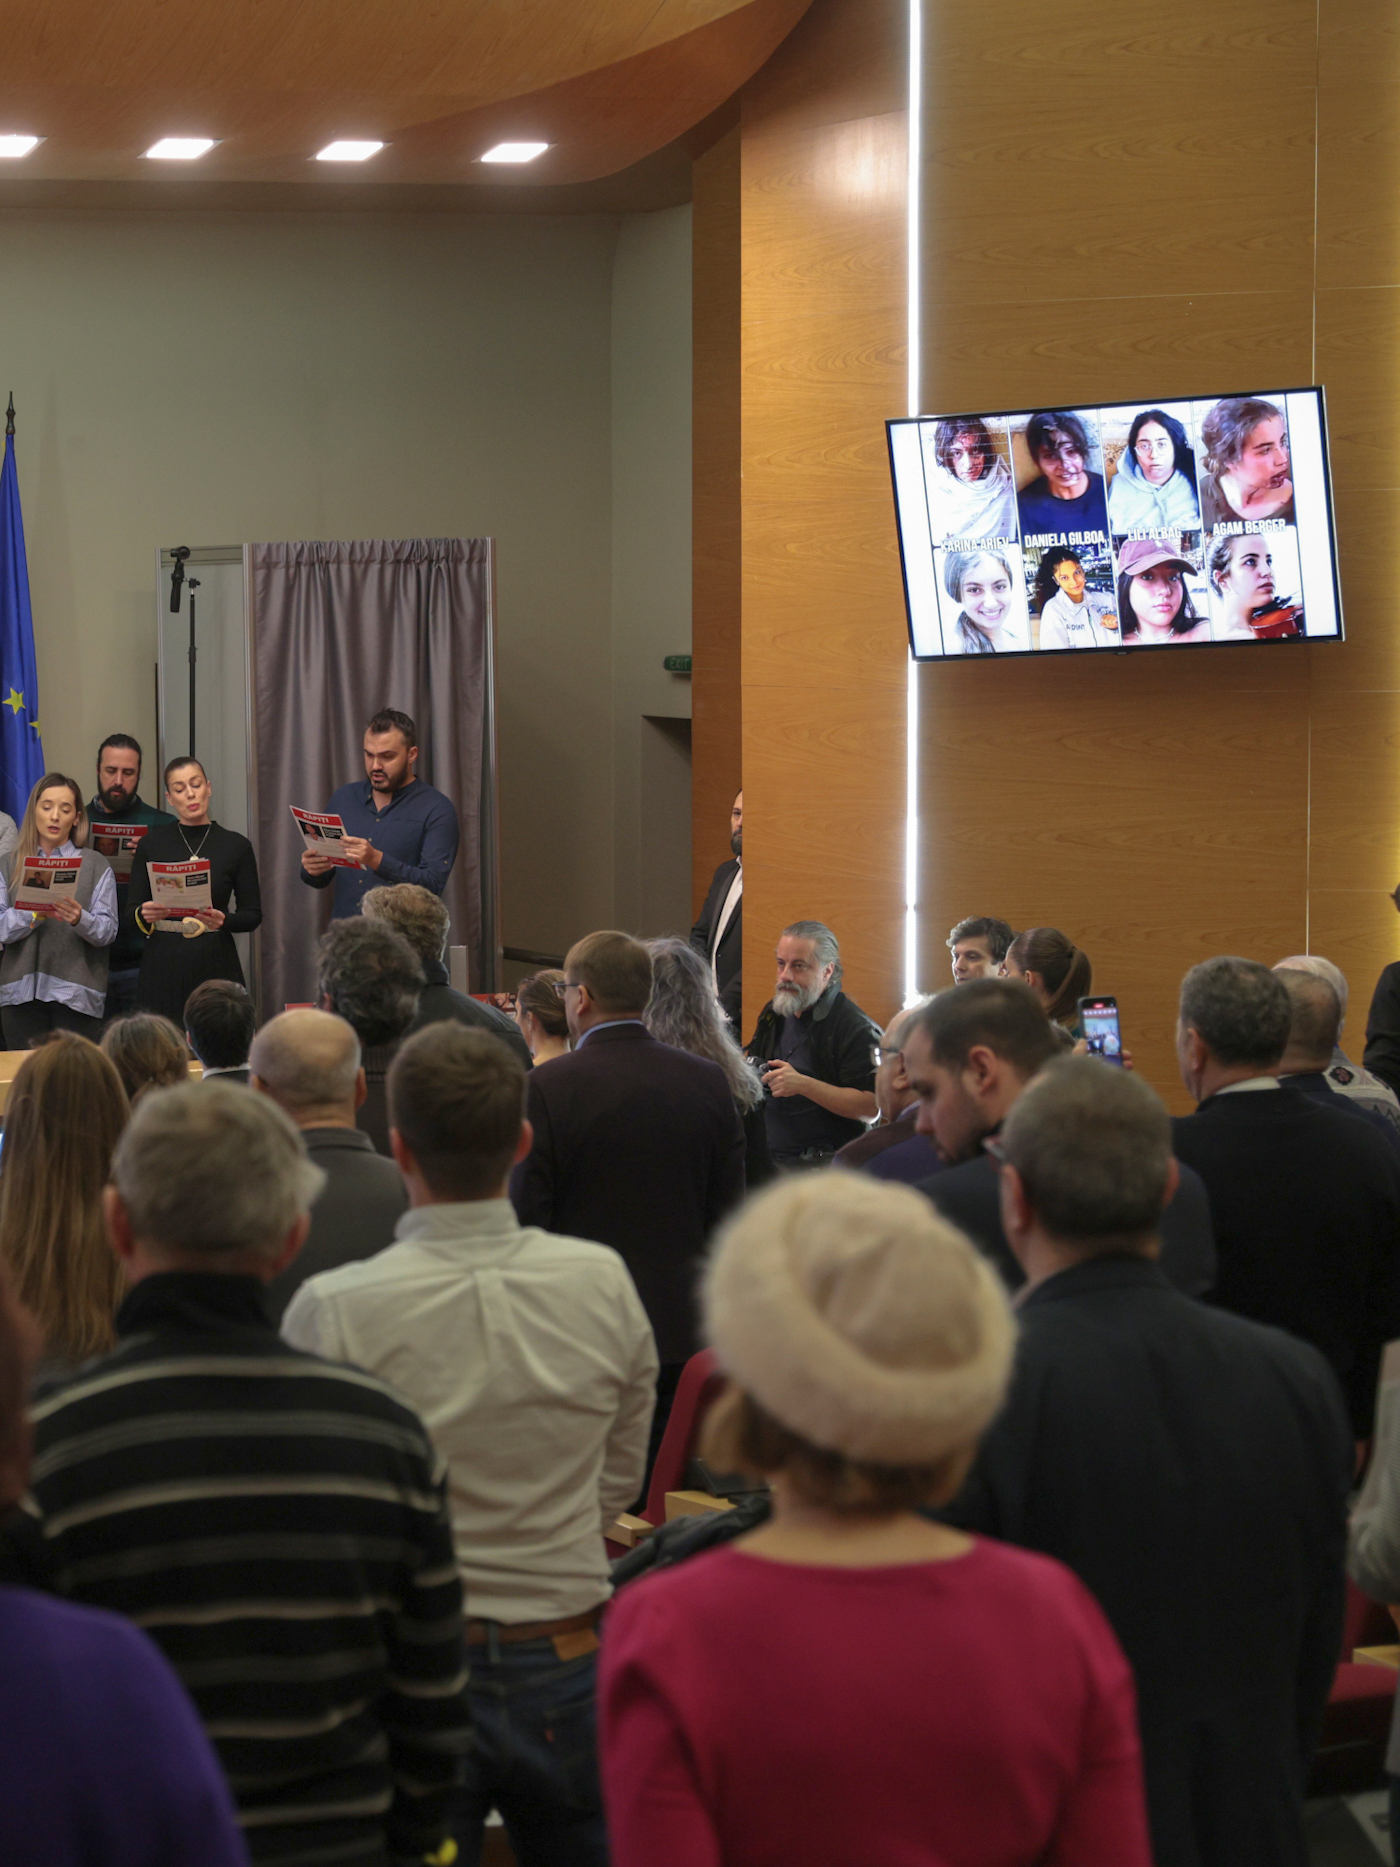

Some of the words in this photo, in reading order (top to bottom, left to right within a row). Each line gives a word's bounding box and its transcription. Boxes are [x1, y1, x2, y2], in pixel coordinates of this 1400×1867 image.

[1128, 528, 1147, 541] LILI
[1149, 525, 1182, 541] ALBAG
[1213, 521, 1244, 536] AGAM
[1244, 518, 1286, 534] BERGER
[1024, 533, 1067, 548] DANIELA
[1068, 530, 1105, 545] GILBOA
